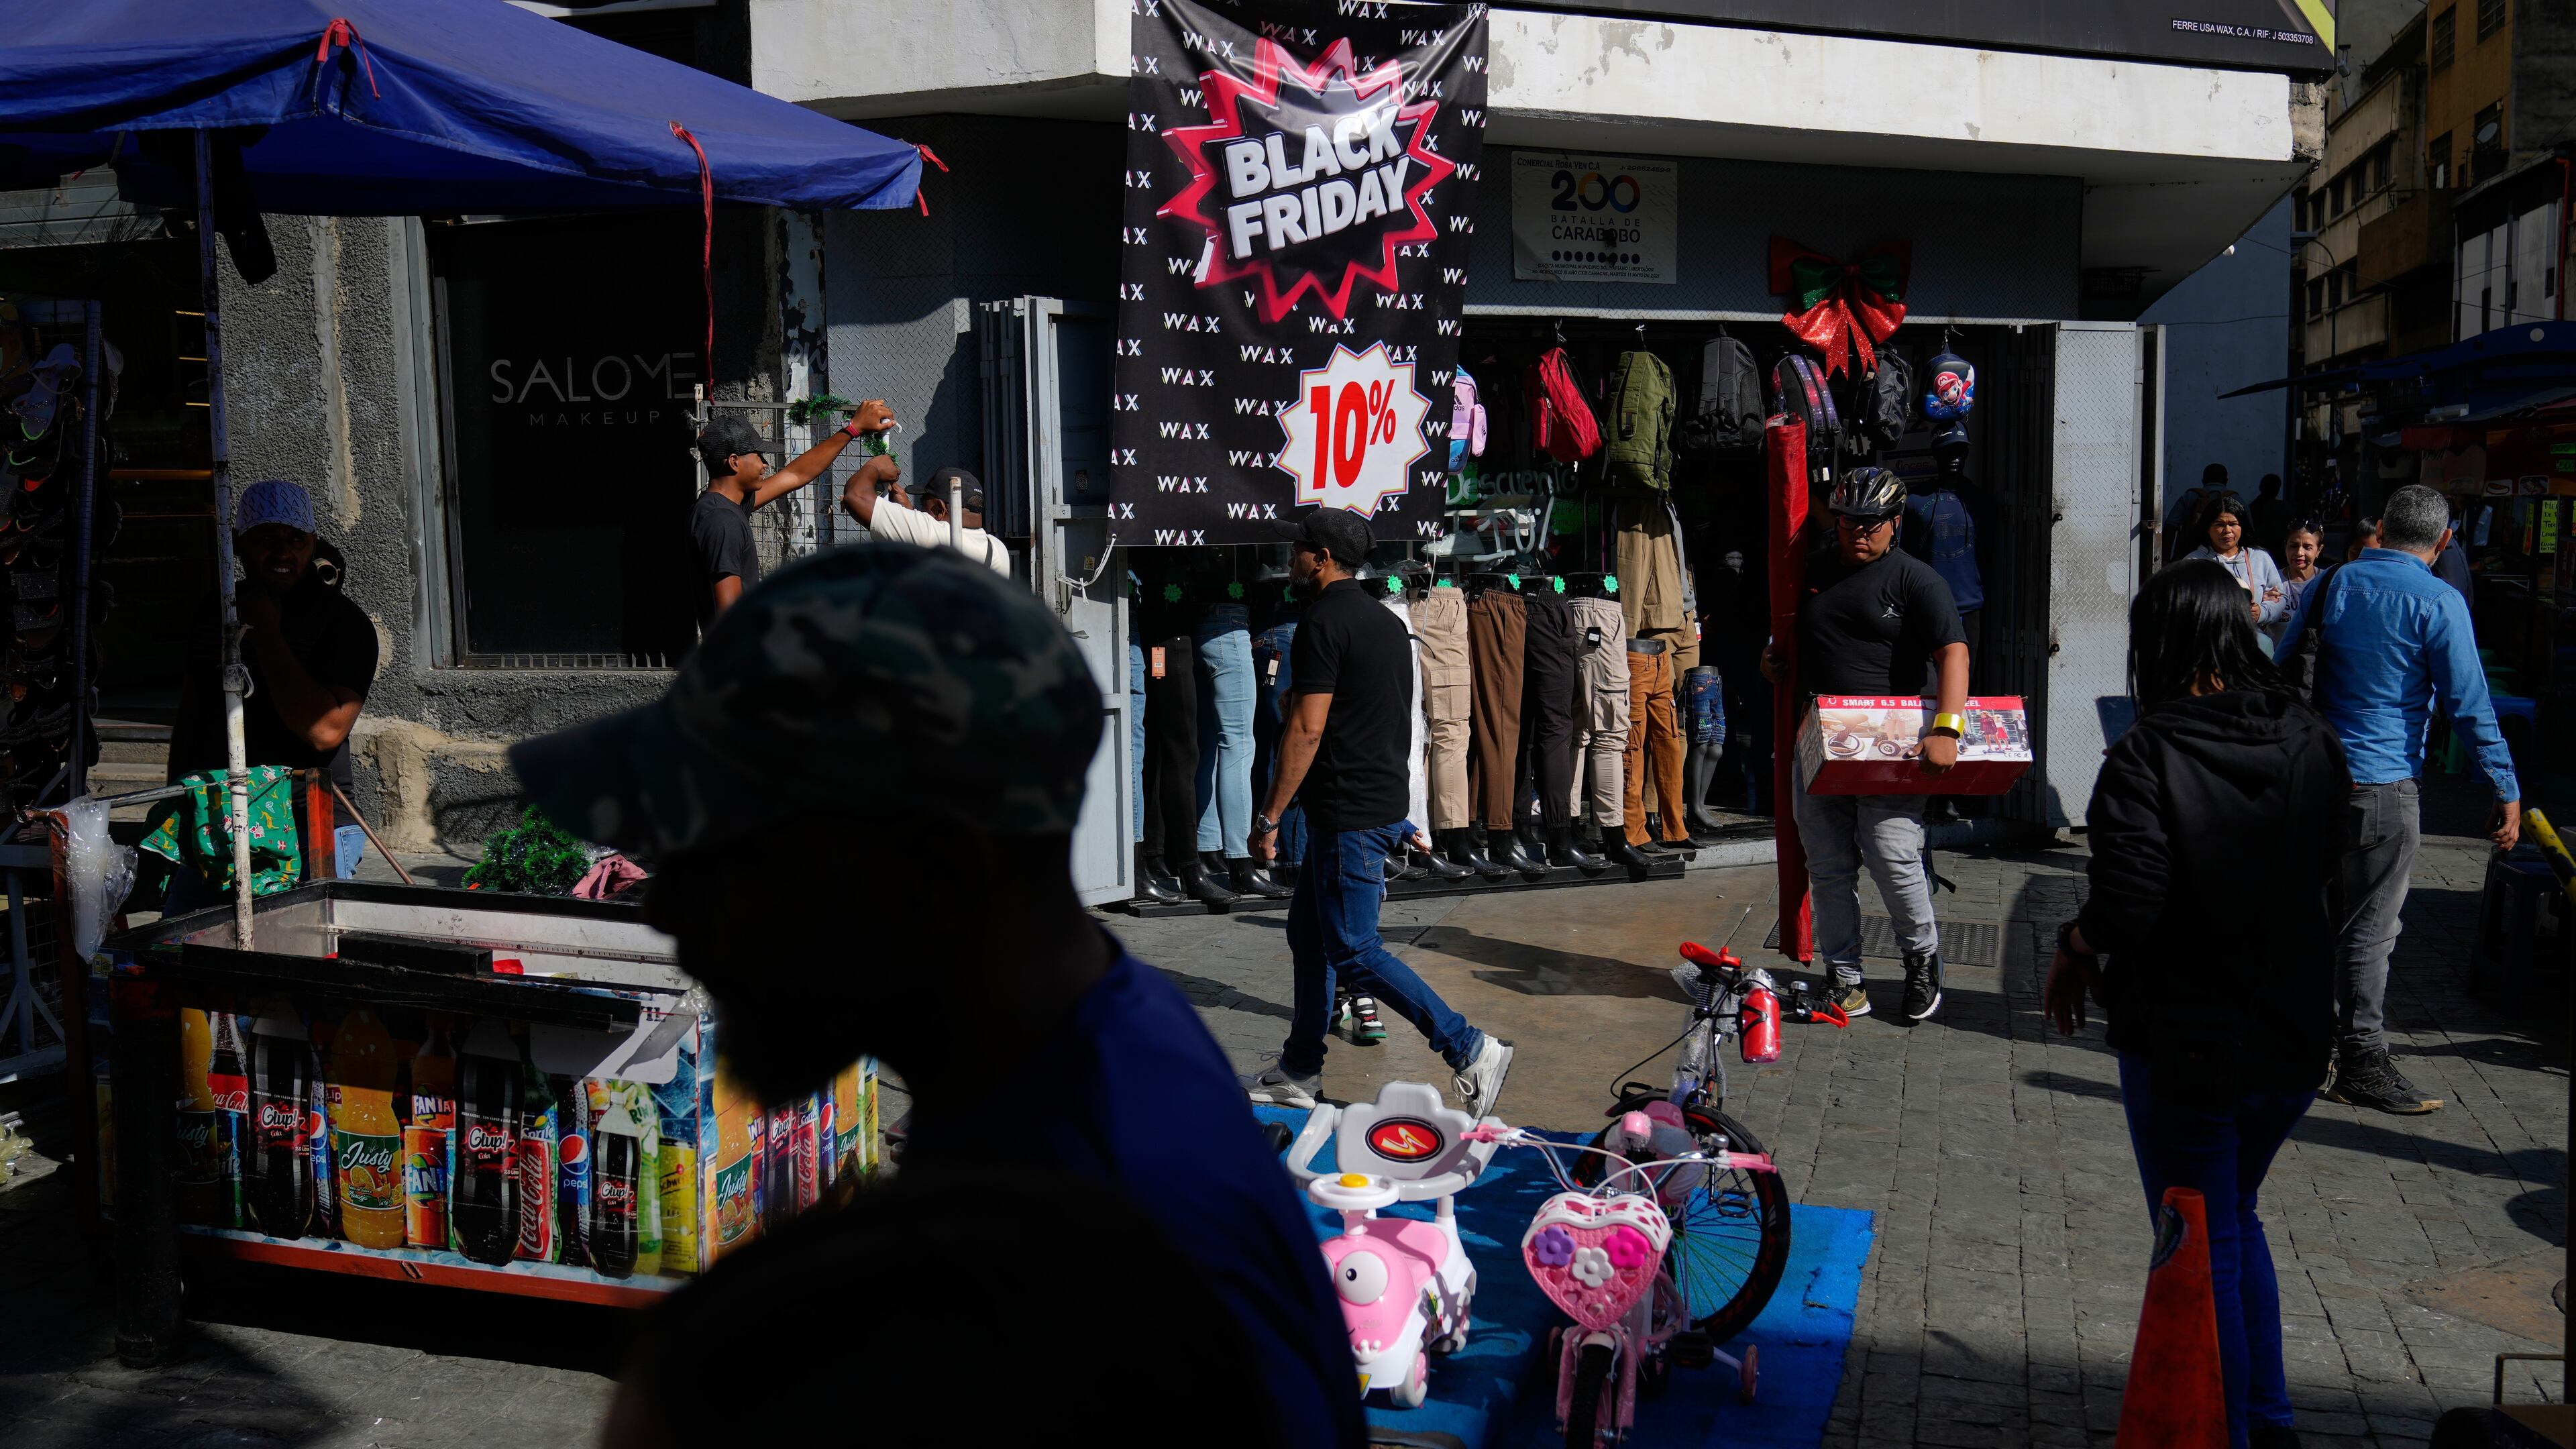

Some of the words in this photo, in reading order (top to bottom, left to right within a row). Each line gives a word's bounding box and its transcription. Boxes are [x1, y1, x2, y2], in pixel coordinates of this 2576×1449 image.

[1131, 0, 1160, 17] AX
[1338, 0, 1388, 19] WAX
[1259, 21, 1317, 46] WAX
[1400, 30, 1446, 46] WAX
[2172, 20, 2198, 31] FERRE
[2200, 23, 2215, 33] USA
[2216, 25, 2235, 36] WAX,
[2237, 27, 2251, 37] C.A.
[2252, 29, 2256, 38] /
[2257, 30, 2271, 39] RIF:
[2272, 32, 2276, 40] J
[2277, 32, 2314, 44] 503353708
[1183, 32, 1236, 59] WAX
[1131, 55, 1159, 74] AX
[1128, 112, 1156, 132] AX
[1225, 104, 1401, 199] BLACK
[1126, 170, 1152, 189] AX
[1551, 170, 1641, 213] 200
[1228, 155, 1410, 260] FRIDAY
[1551, 215, 1615, 225] BATALLA
[1625, 218, 1640, 227] DE
[1123, 227, 1148, 245] AX
[1552, 225, 1641, 243] CARABOBO
[1393, 243, 1430, 258] AX
[1120, 283, 1144, 301] AX
[1376, 293, 1424, 310] WAX
[1164, 313, 1220, 333] WAX
[1309, 317, 1355, 334] WAX
[1117, 339, 1142, 356] AX
[1240, 345, 1293, 364] WAX
[1389, 345, 1417, 362] AX
[490, 352, 696, 404] SALOME
[1161, 368, 1214, 386] WAX
[1114, 394, 1139, 411] AX
[1235, 398, 1287, 417] WAX
[530, 411, 659, 426] MAKEUP
[1159, 422, 1210, 439] WAX
[1310, 379, 1396, 490] 10%
[1111, 449, 1137, 466] AX
[1157, 476, 1209, 492] WAX
[1108, 503, 1135, 519] AX
[1227, 503, 1277, 520] WAX
[1375, 496, 1400, 512] AX
[1919, 495, 1944, 516] LACOSE
[1155, 529, 1205, 545] WAX
[1842, 699, 1876, 707] SMART
[413, 1095, 451, 1114] FANTA
[176, 1118, 209, 1148] usty
[341, 1140, 392, 1173] Justy
[718, 1169, 748, 1210] Justy
